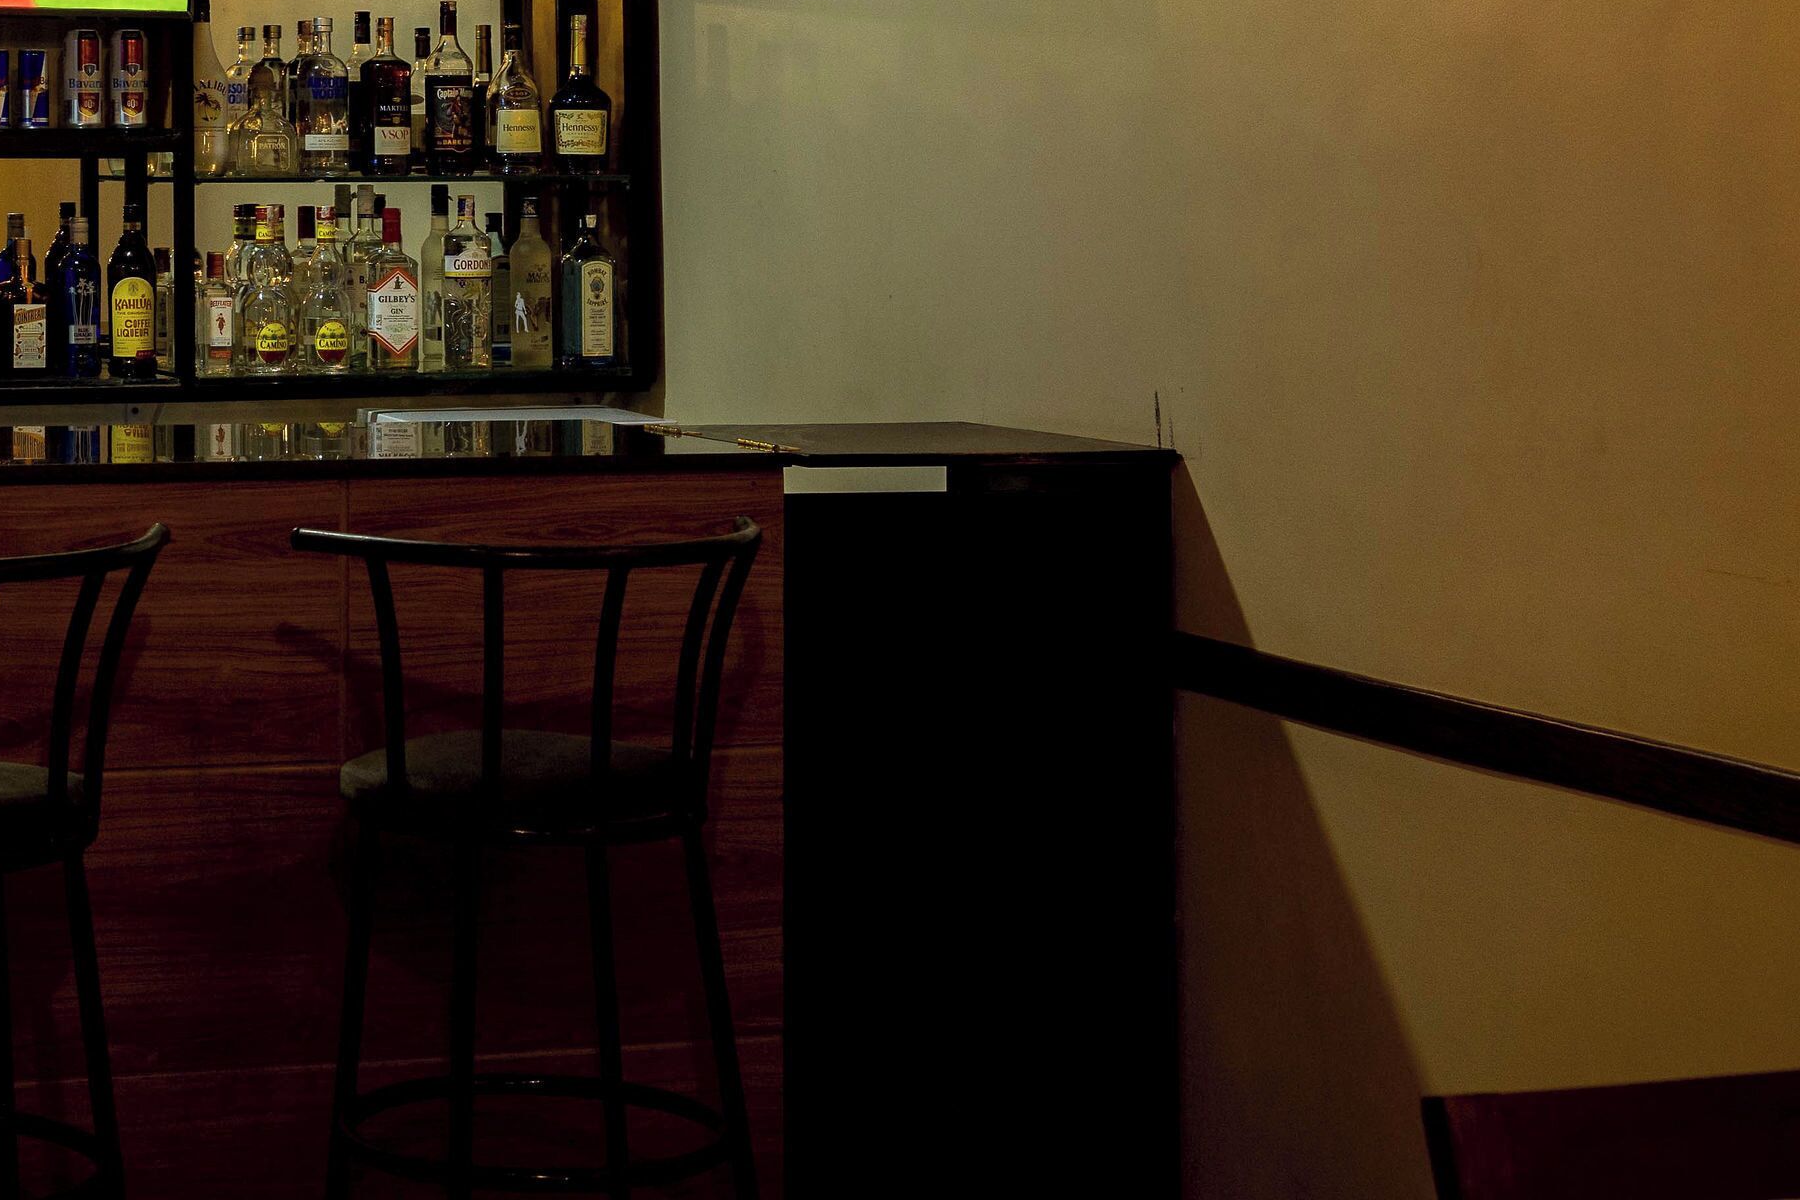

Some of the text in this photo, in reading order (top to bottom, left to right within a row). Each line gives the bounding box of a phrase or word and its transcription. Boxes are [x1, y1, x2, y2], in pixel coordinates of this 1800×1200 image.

[503, 123, 537, 132] Hennessy
[561, 122, 599, 132] Hennessy
[381, 129, 409, 140] VSOP
[114, 294, 152, 311] KAHLÚA
[378, 293, 416, 303] GILBEY'S
[124, 319, 151, 329] COFFEE
[116, 328, 149, 338] LIQUEUR
